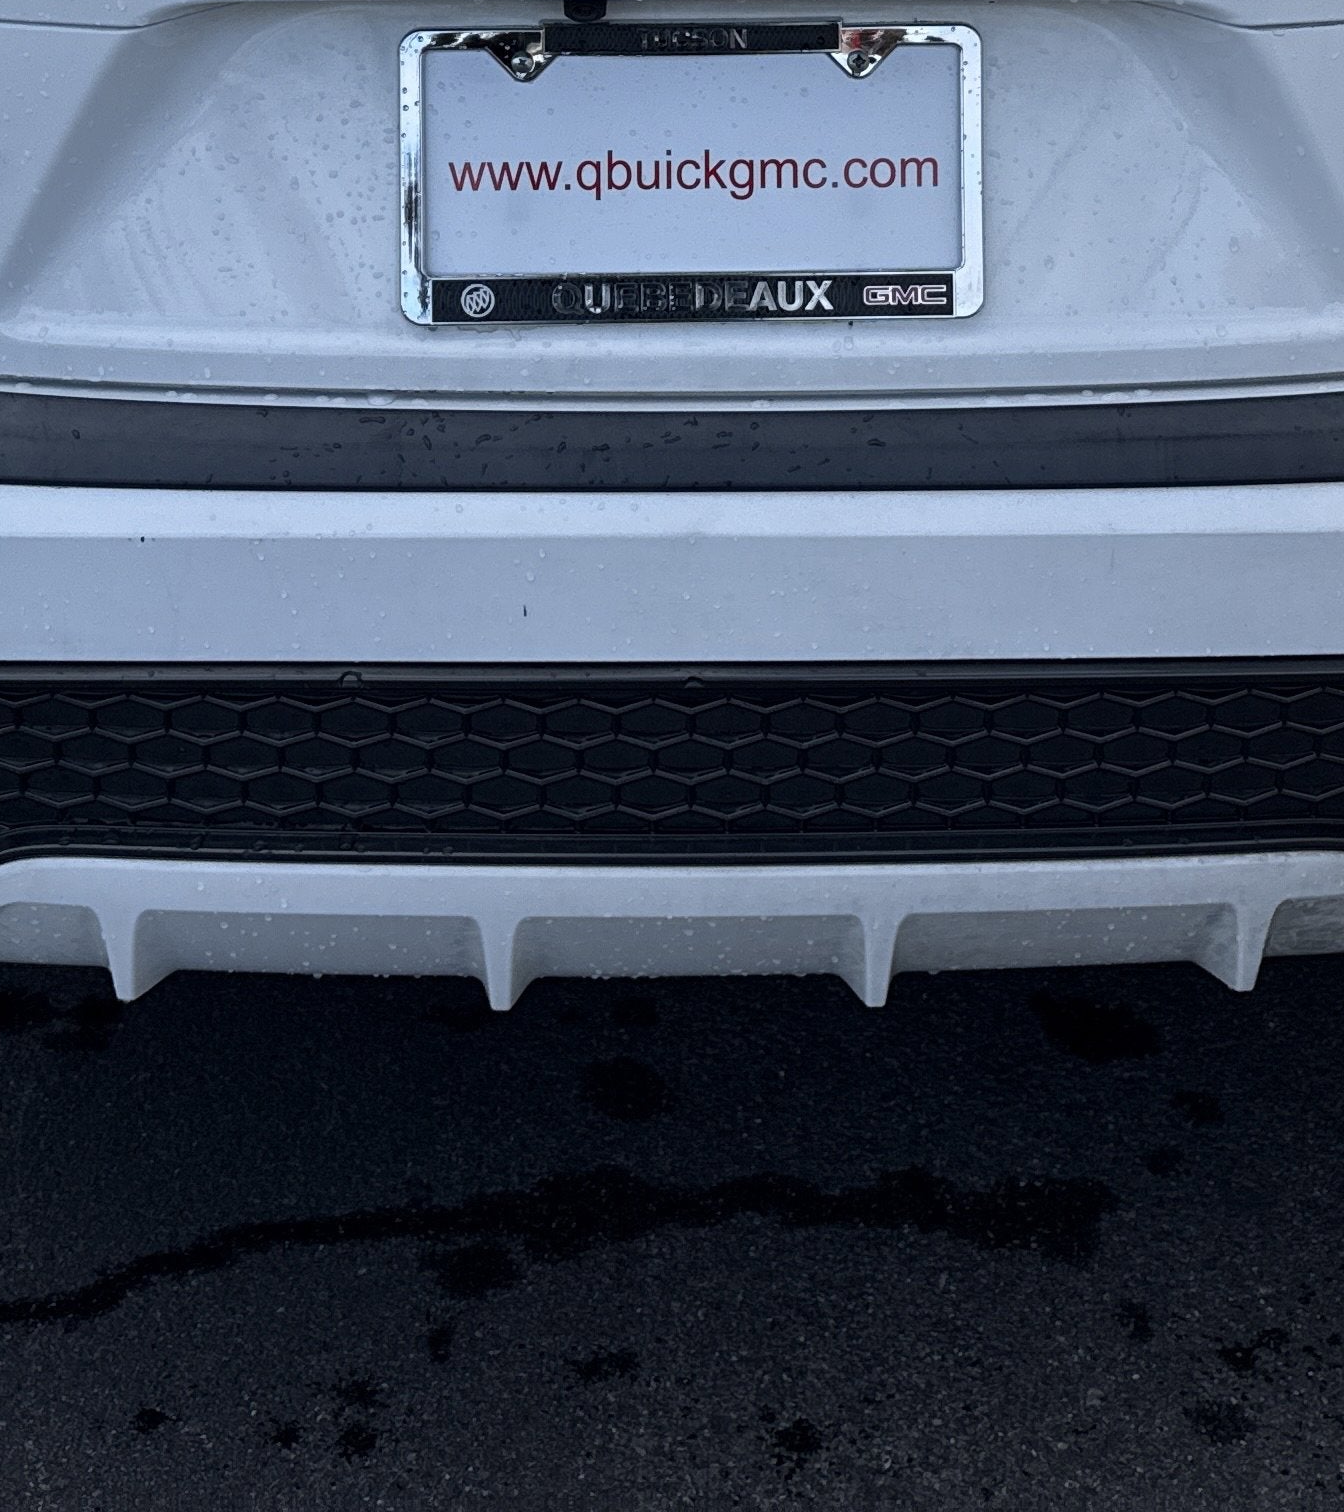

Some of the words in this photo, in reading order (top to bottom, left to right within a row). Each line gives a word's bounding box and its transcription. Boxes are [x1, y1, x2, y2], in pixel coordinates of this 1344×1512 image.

[448, 149, 939, 200] www.qbuickgmc.com
[552, 280, 834, 315] QUEBEDEAUX
[863, 285, 947, 306] GMC
